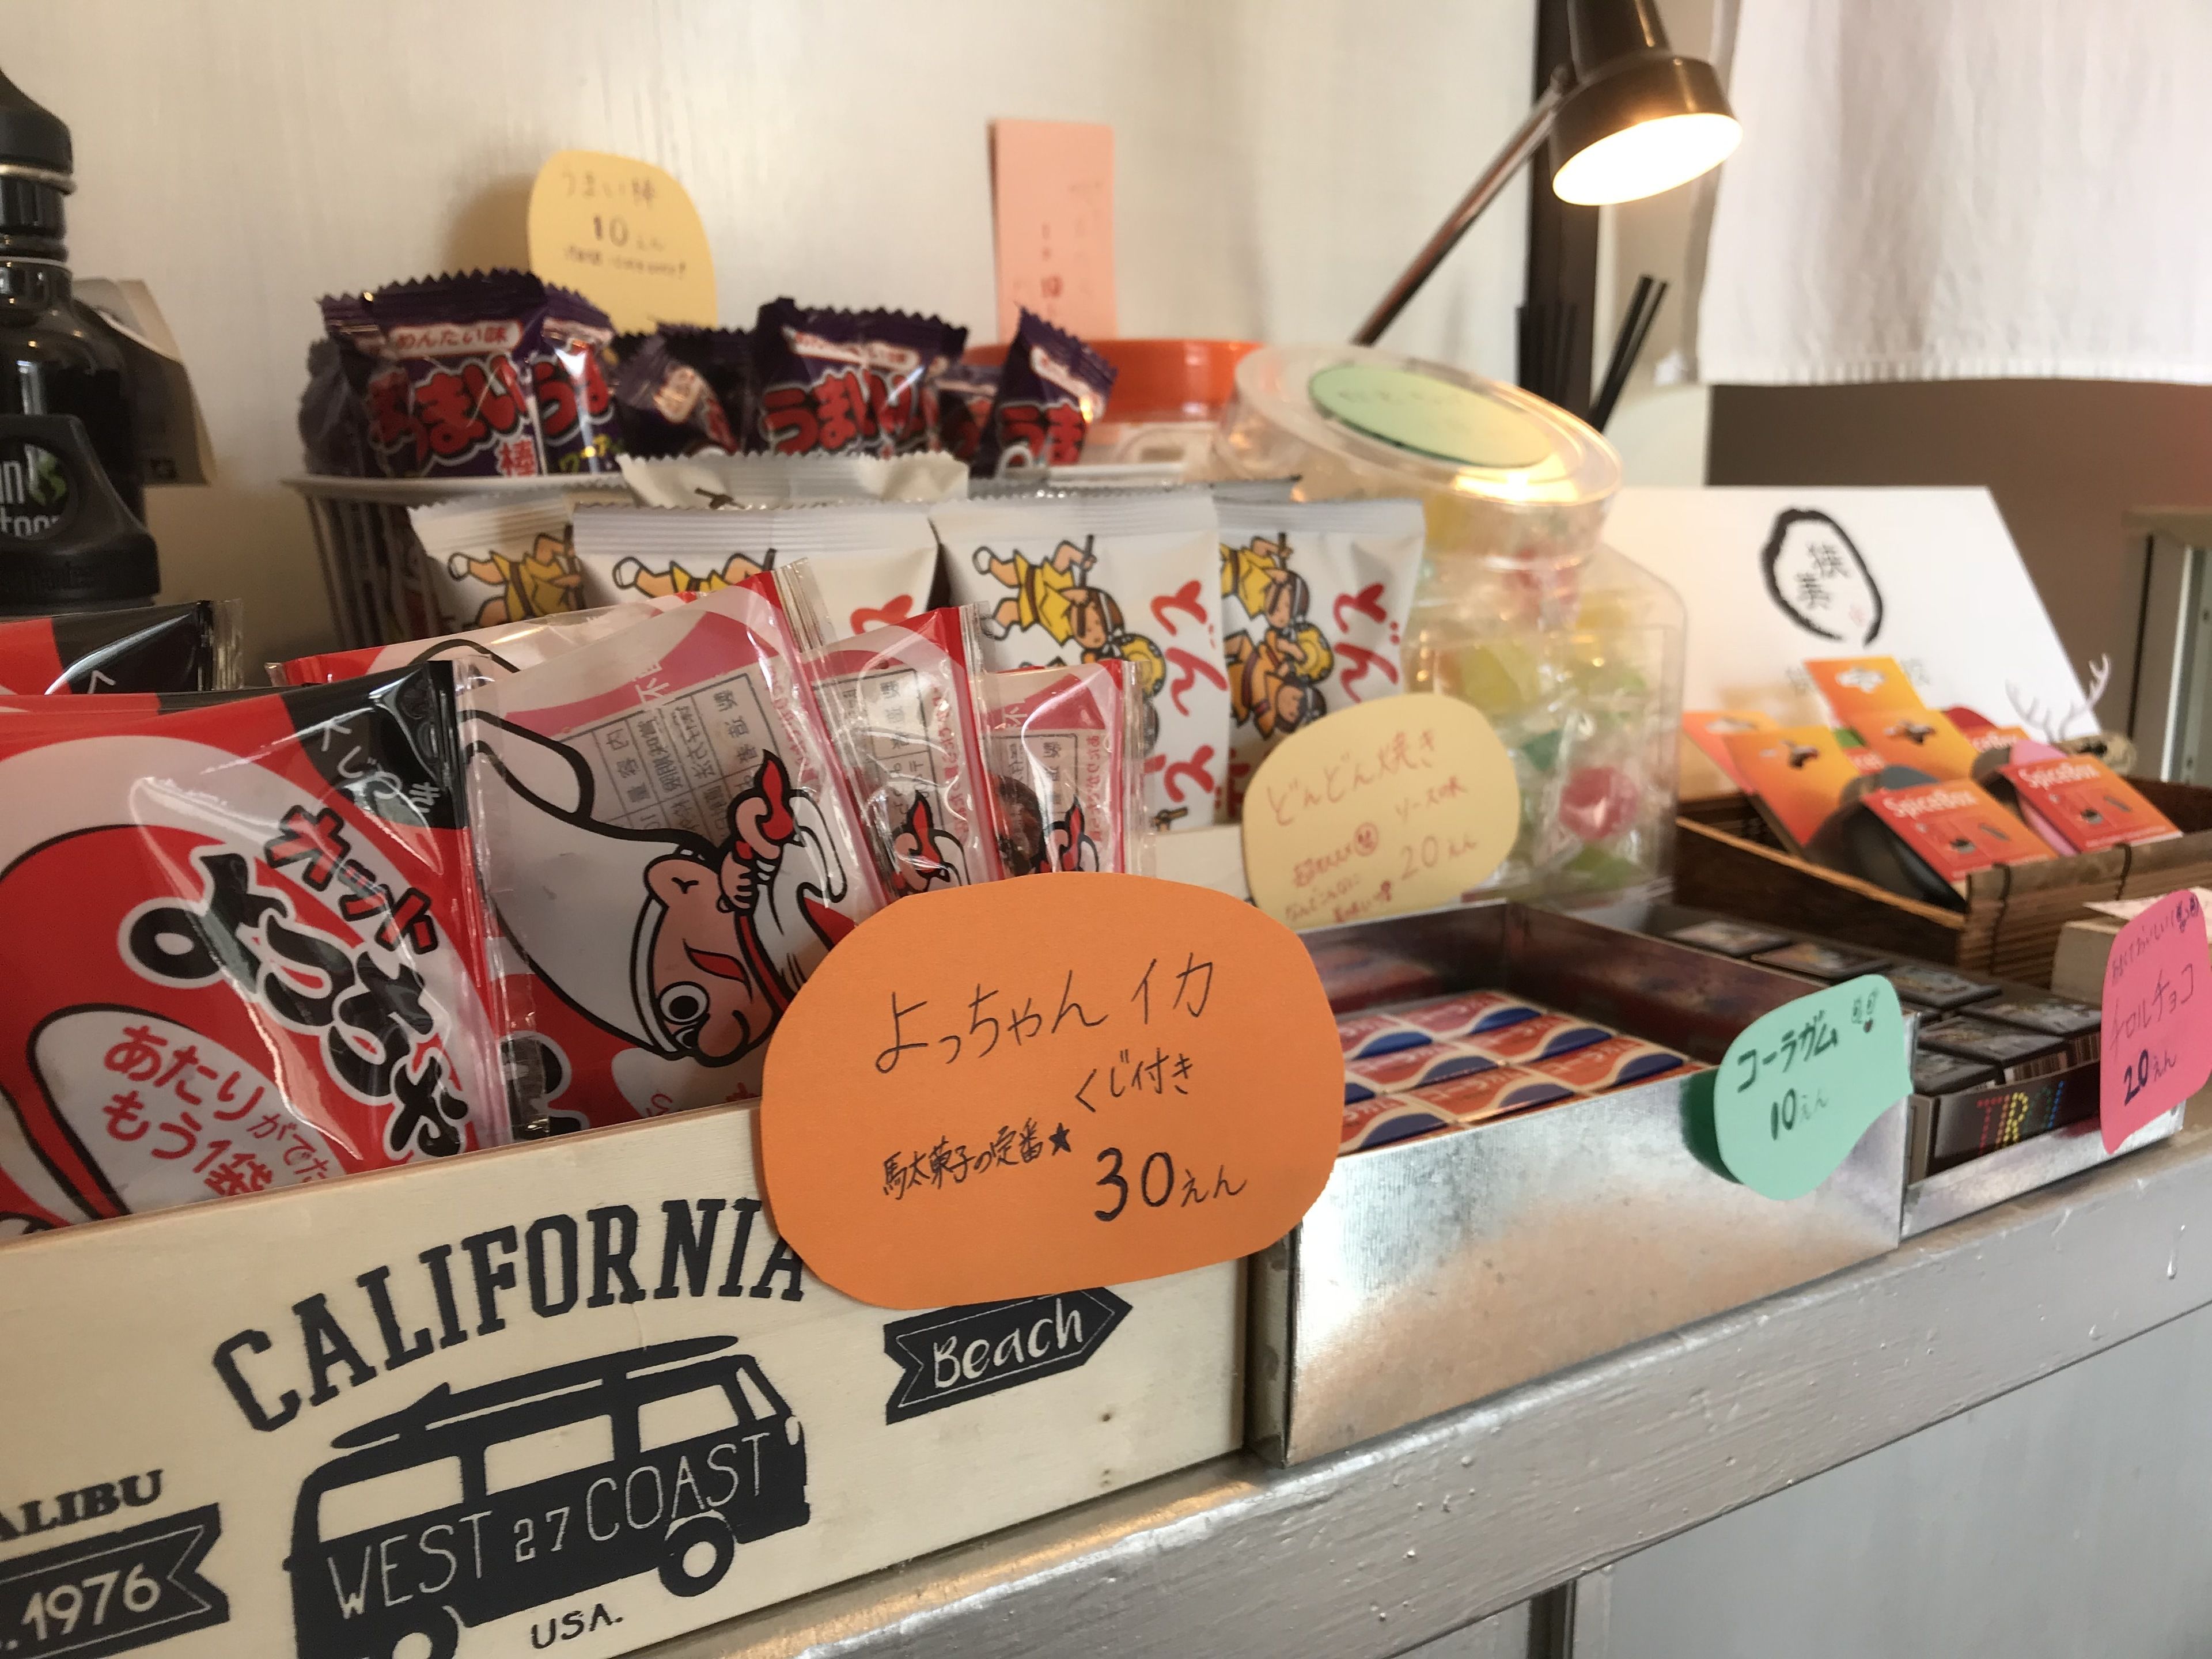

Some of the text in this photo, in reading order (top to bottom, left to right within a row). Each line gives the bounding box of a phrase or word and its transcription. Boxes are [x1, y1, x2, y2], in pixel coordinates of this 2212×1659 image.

[875, 952, 1214, 1074] よっちゃん イカ
[1074, 1047, 1194, 1113] くじ付き
[1093, 1146, 1247, 1222] 30えん
[212, 1198, 805, 1433] CALIFORNIA
[933, 1297, 1083, 1388] Beach
[327, 1431, 770, 1620] WEST 27 COAST
